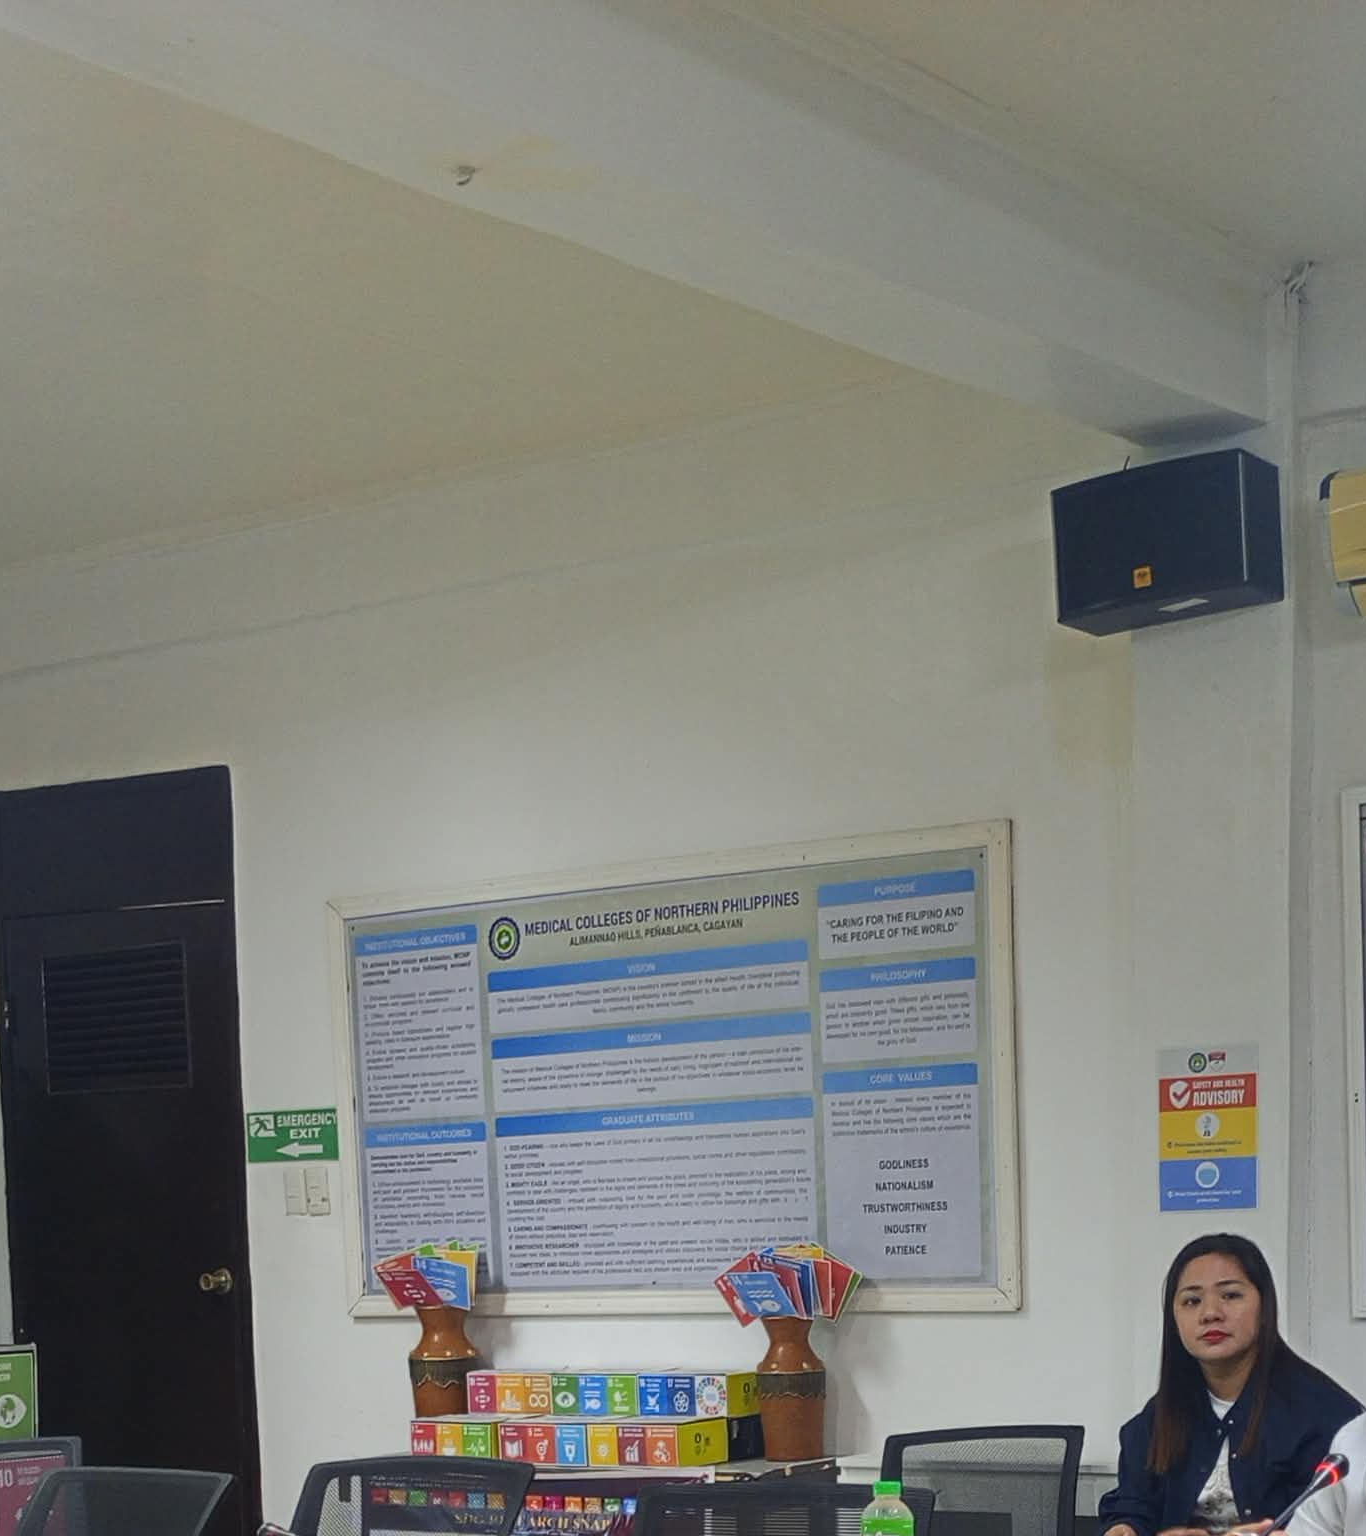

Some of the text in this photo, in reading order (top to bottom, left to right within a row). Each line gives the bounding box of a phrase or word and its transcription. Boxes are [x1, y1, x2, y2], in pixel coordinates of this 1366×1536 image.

[525, 892, 799, 936] MEDICAL COLLEGES OF NORTHERN PHILIPPINES
[827, 907, 963, 928] "CARING FOR THE FILIPINO AND
[569, 932, 616, 946] ALIMANNAO
[703, 919, 743, 931] CAGAYAN
[831, 922, 958, 943] THE PEOPLE OF THE WORLD"
[1192, 1088, 1245, 1107] ADVISORY
[276, 1114, 336, 1129] EMERGENCY
[289, 1127, 321, 1139] EXIT
[878, 1158, 930, 1170] GODLINESS
[875, 1179, 934, 1192] NATIONALISM
[862, 1201, 948, 1214] TRUSTWORTHINESS
[883, 1223, 928, 1235] INDUSTRY
[885, 1245, 928, 1257] PATIENCE
